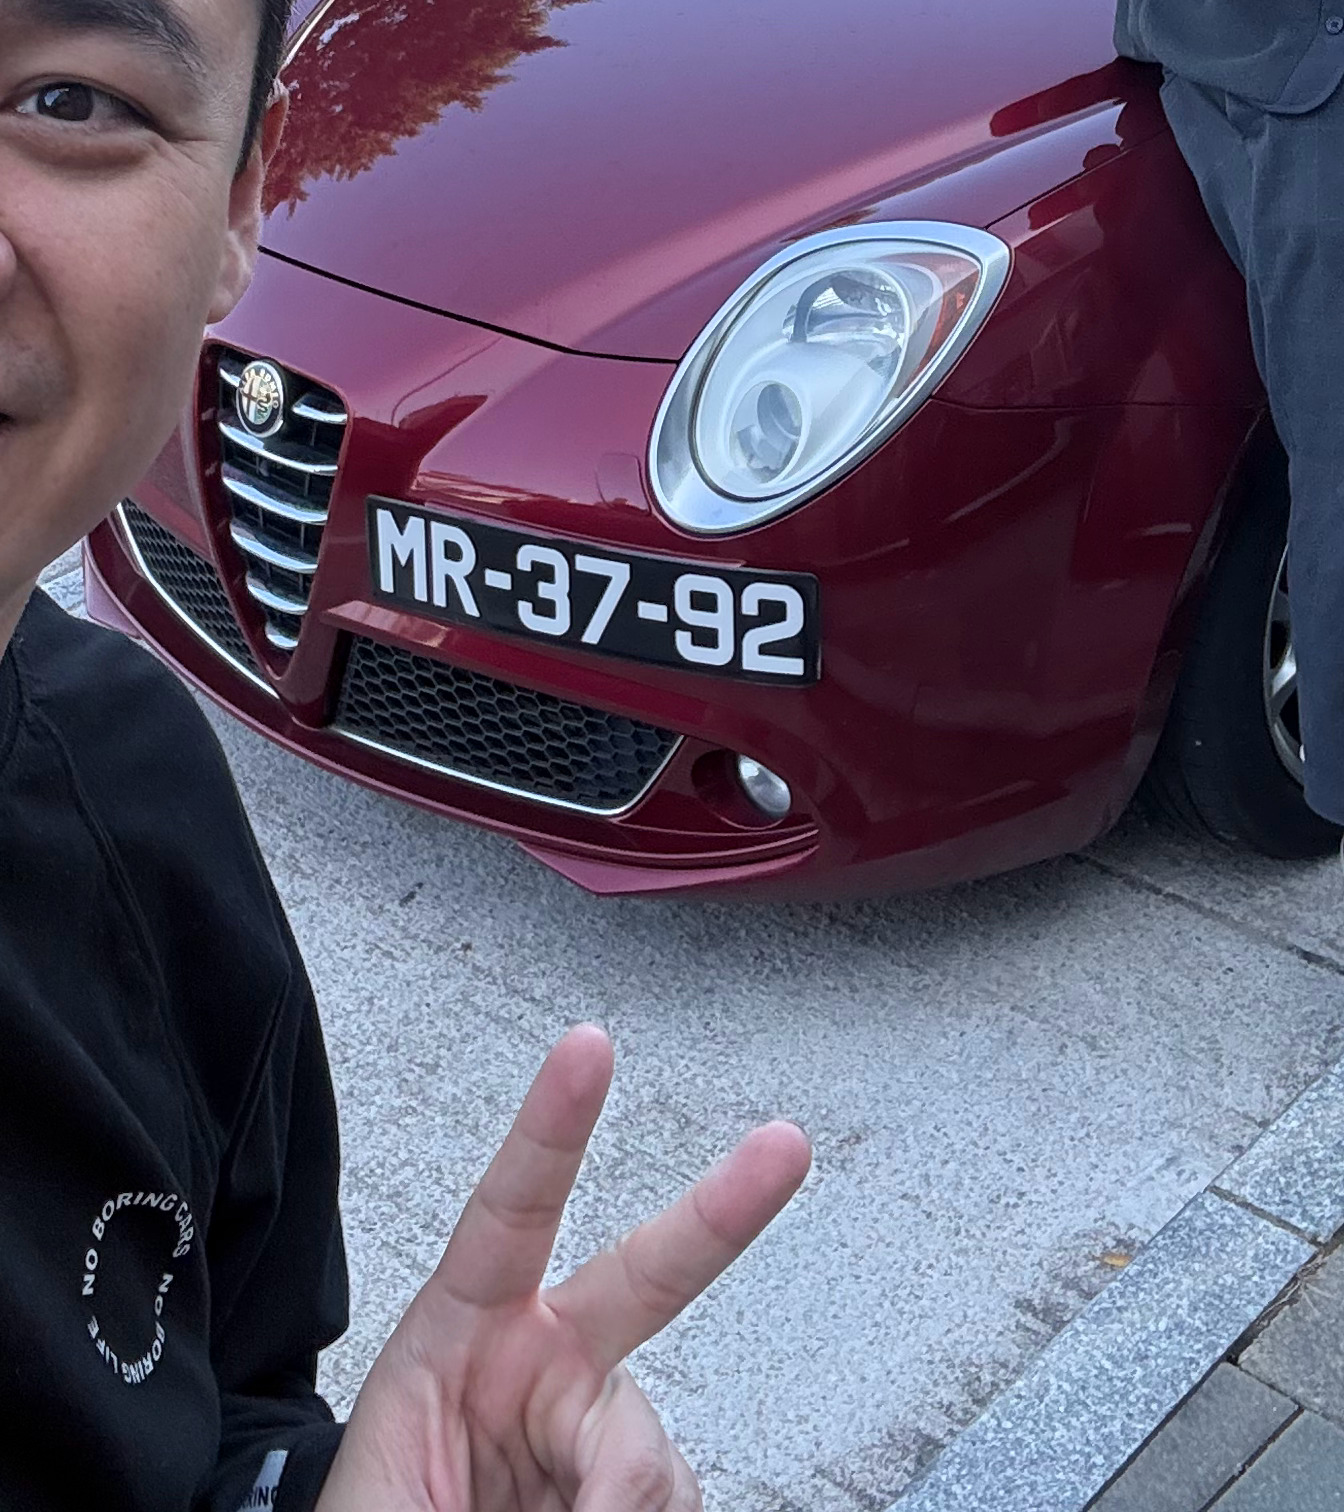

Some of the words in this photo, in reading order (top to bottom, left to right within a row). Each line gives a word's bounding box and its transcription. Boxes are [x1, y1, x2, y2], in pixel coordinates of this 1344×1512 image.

[376, 508, 805, 676] MR-37-92
[82, 1248, 98, 1296] NO
[92, 1191, 179, 1241] BORING
[172, 1201, 195, 1258] CARS
[154, 1273, 174, 1316] NO
[87, 1315, 119, 1374] LIFE
